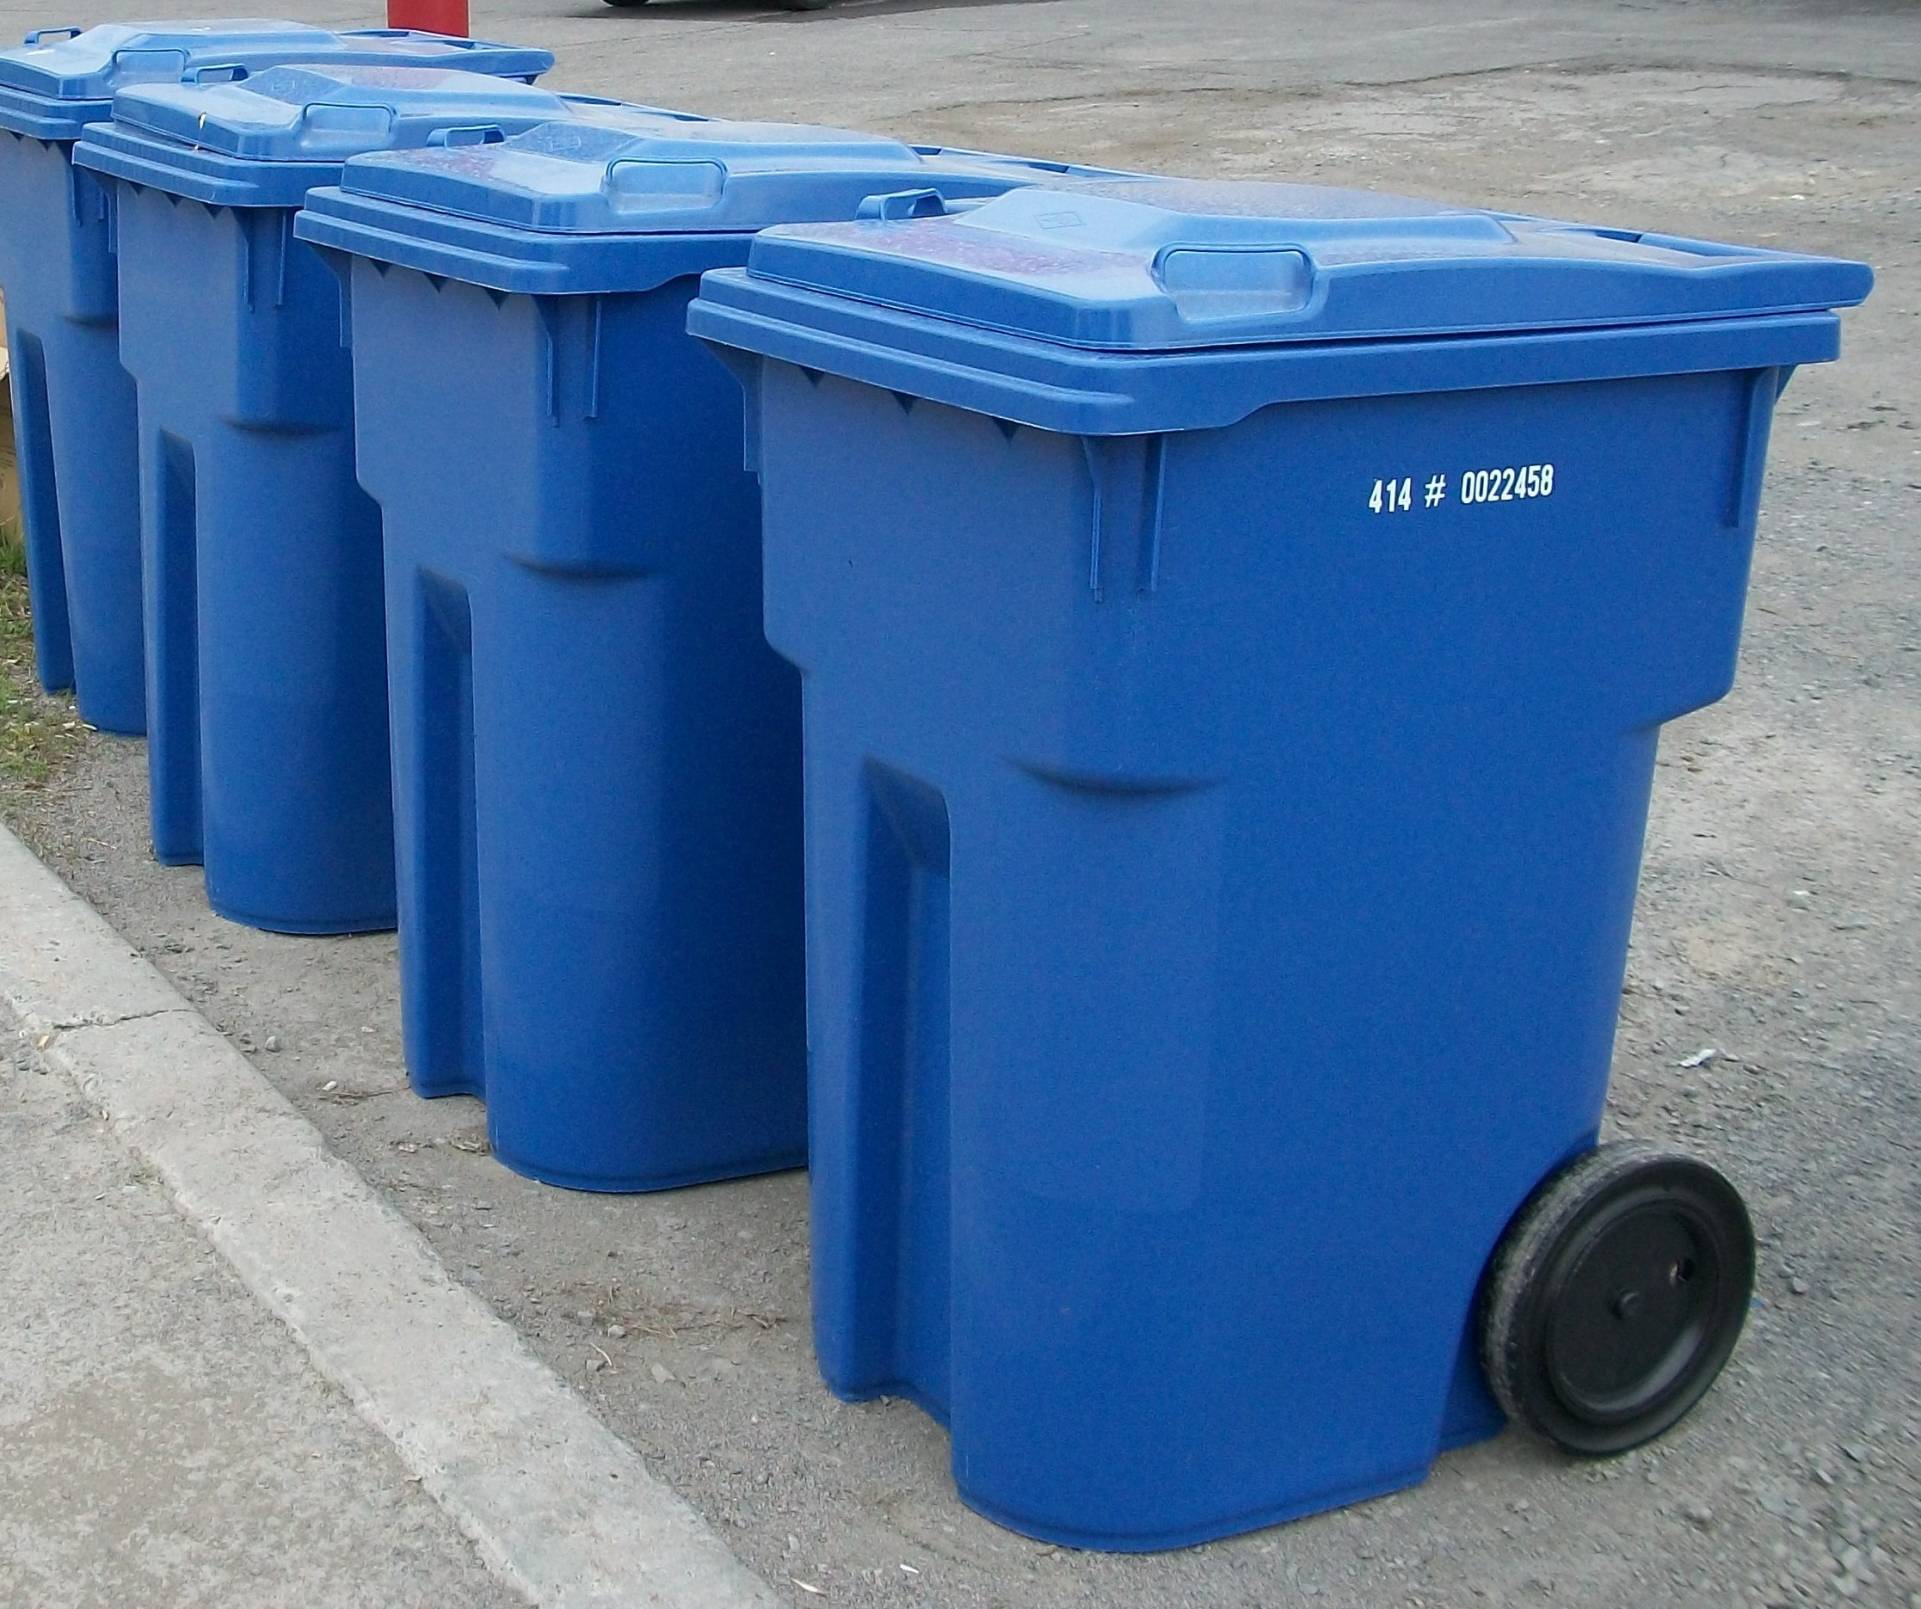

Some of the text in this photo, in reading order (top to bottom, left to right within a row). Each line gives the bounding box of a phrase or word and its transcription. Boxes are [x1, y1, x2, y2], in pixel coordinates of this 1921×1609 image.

[1368, 464, 1554, 513] 414 # 0022458
